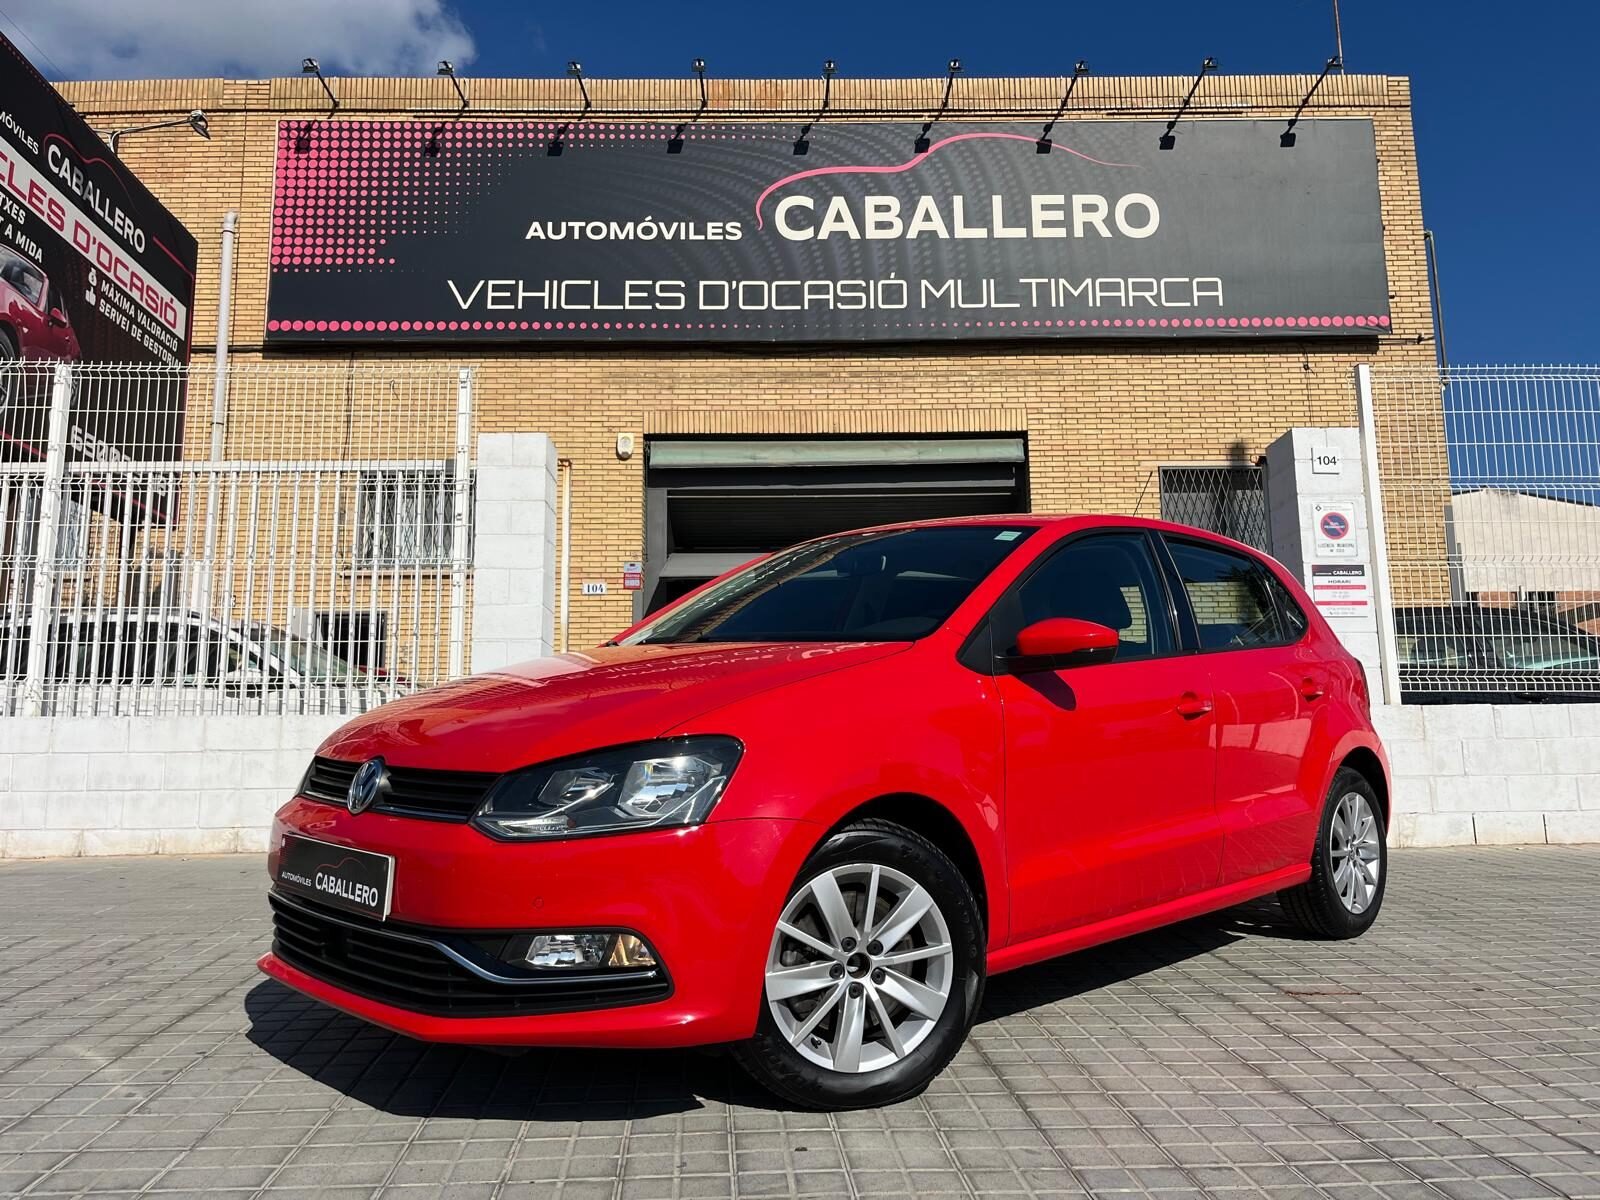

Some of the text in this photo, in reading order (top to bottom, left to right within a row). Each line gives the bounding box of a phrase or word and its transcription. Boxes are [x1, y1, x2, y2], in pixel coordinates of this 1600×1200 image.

[48, 144, 146, 254] CABALLERO
[525, 192, 1161, 241] AUTOMÓVILES CABALLERO
[4, 223, 44, 264] A MIDA
[73, 219, 178, 330] D'OCASIÓ
[447, 272, 1225, 311] VEHICLES D'OCASIÓ MULTIMARCA
[99, 299, 130, 332] SERVEI
[131, 324, 143, 342] DE
[101, 279, 179, 352] MÀXIMA VALORACIÓ
[1316, 455, 1337, 466] 104
[586, 584, 603, 593] 104
[281, 871, 379, 908] AUTOMÓVILES CABALLERO
